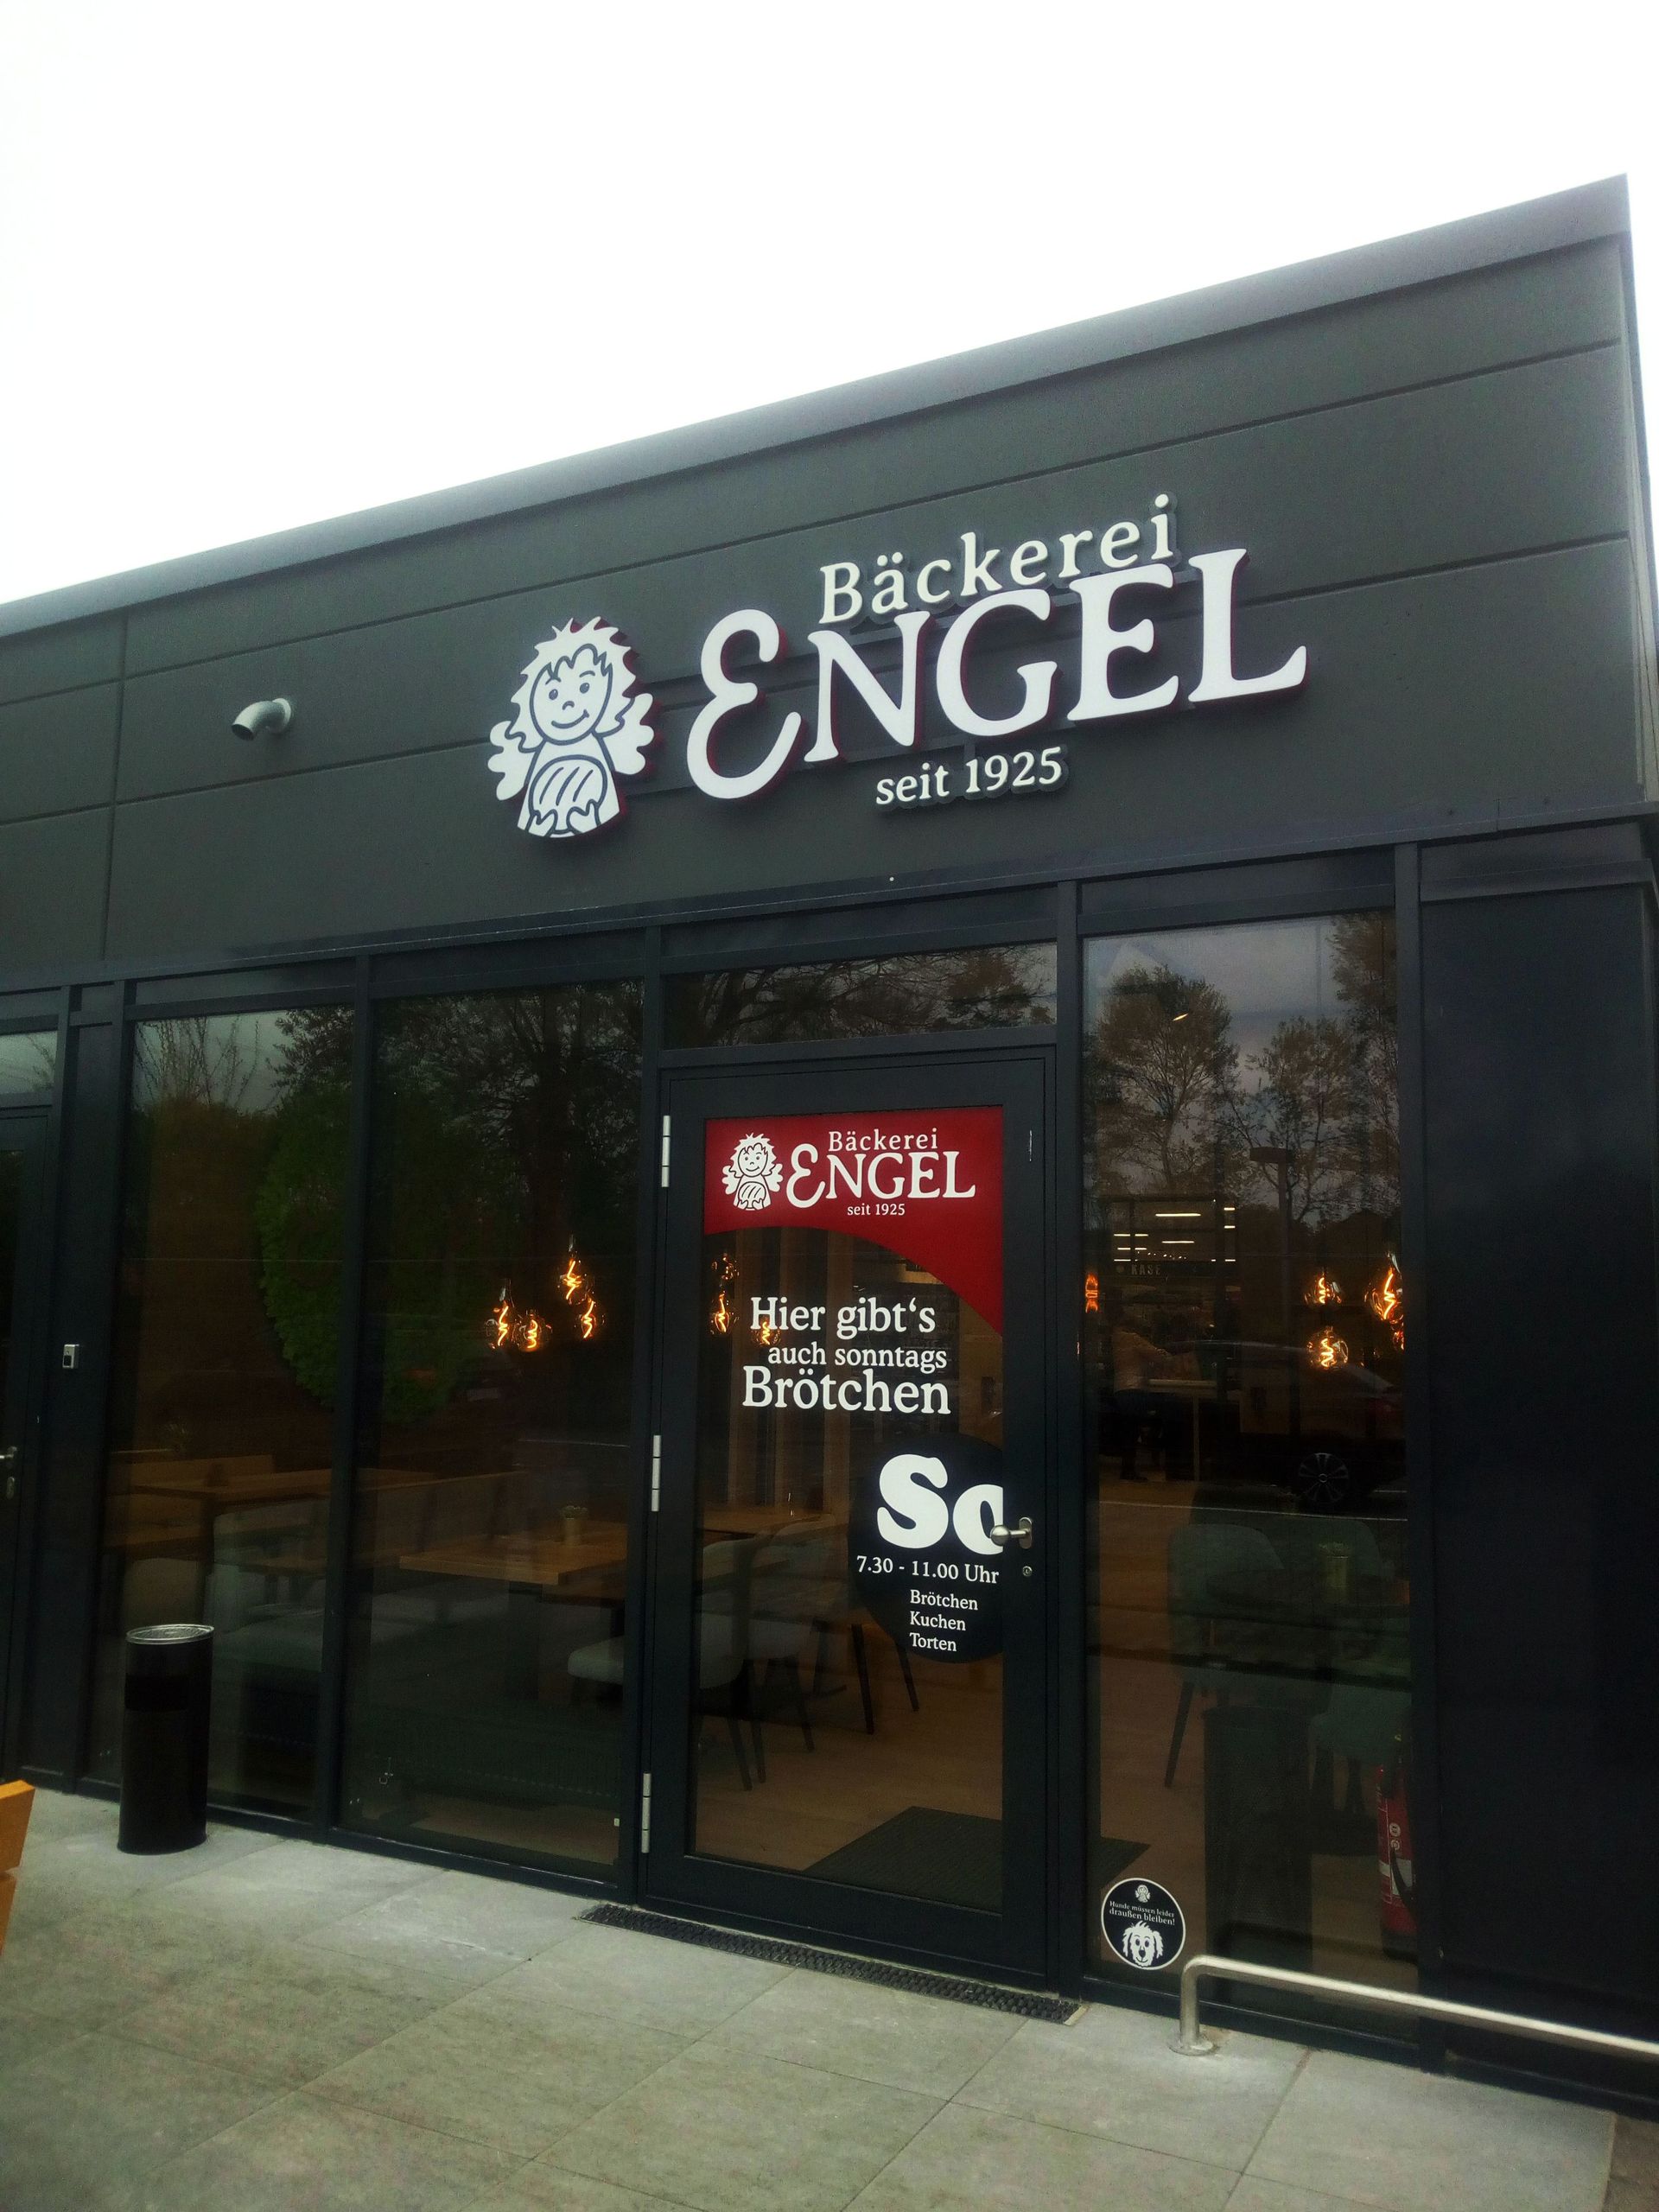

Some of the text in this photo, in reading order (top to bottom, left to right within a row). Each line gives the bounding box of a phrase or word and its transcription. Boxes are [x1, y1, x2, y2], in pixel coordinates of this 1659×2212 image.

[818, 493, 1173, 625] Bäckerei
[686, 548, 1306, 799] ENGEL
[875, 746, 1062, 805] seit 1925
[828, 1127, 938, 1151] Bäckerei
[785, 1143, 976, 1208] ENGEL
[847, 1202, 906, 1216] seit 1925
[750, 1296, 826, 1332] Hier
[767, 1341, 947, 1374] auch sonntags
[741, 1365, 951, 1414] Brötchen
[856, 1555, 893, 1574] 7.30
[912, 1560, 959, 1580] 11.00
[964, 1563, 1000, 1584] Uhr
[910, 1589, 979, 1611] Brötchen
[910, 1610, 966, 1631] Kuchen
[910, 1631, 957, 1652] Torten
[1109, 1900, 1174, 1918] Hunde müssen leider
[1109, 1907, 1175, 1926] draußen bleiben!
